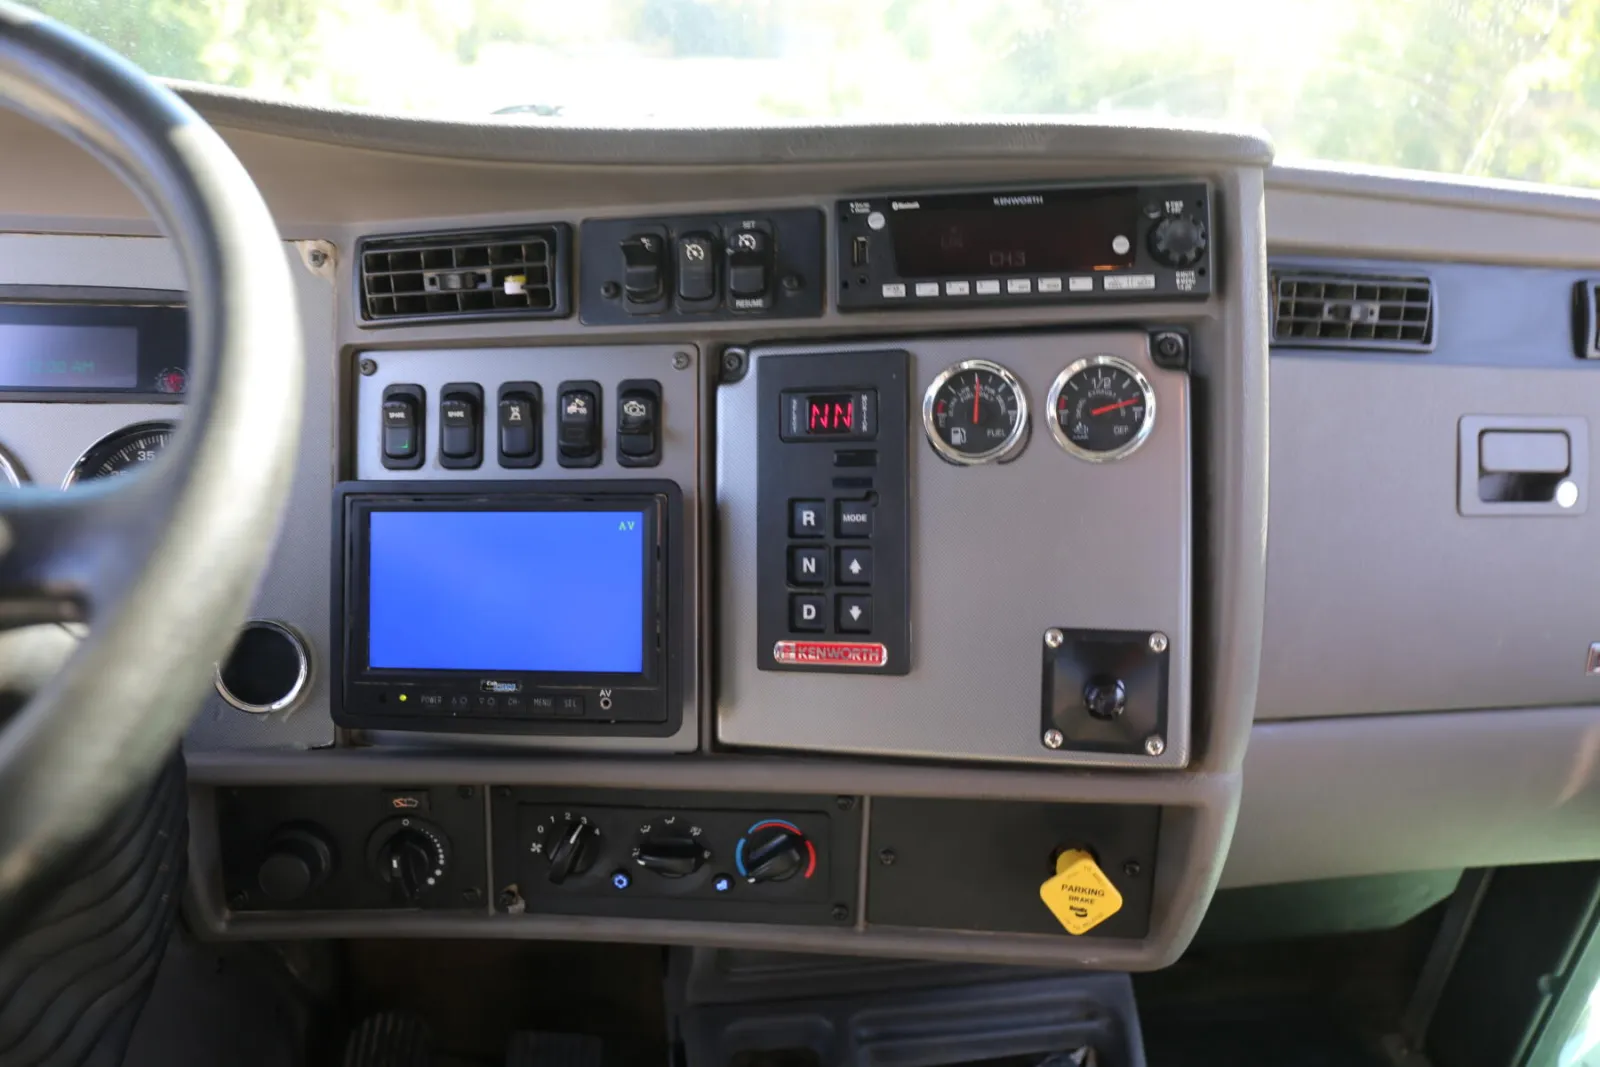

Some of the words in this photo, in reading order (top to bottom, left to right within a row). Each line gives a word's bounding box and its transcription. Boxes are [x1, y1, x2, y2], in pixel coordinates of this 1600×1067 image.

[810, 403, 853, 429] NN
[986, 429, 1006, 438] FUEL
[137, 450, 155, 461] 35
[802, 510, 816, 527] R
[842, 513, 868, 523] MODE
[802, 557, 816, 574] N
[802, 604, 817, 620] D
[798, 646, 880, 661] KENWORTH
[599, 689, 612, 698] AV
[550, 816, 555, 824] 1
[564, 812, 571, 821] 2
[580, 816, 588, 825] 3
[594, 828, 600, 836] 4
[1061, 883, 1105, 897] PARKING
[1068, 895, 1095, 905] BRAKE
